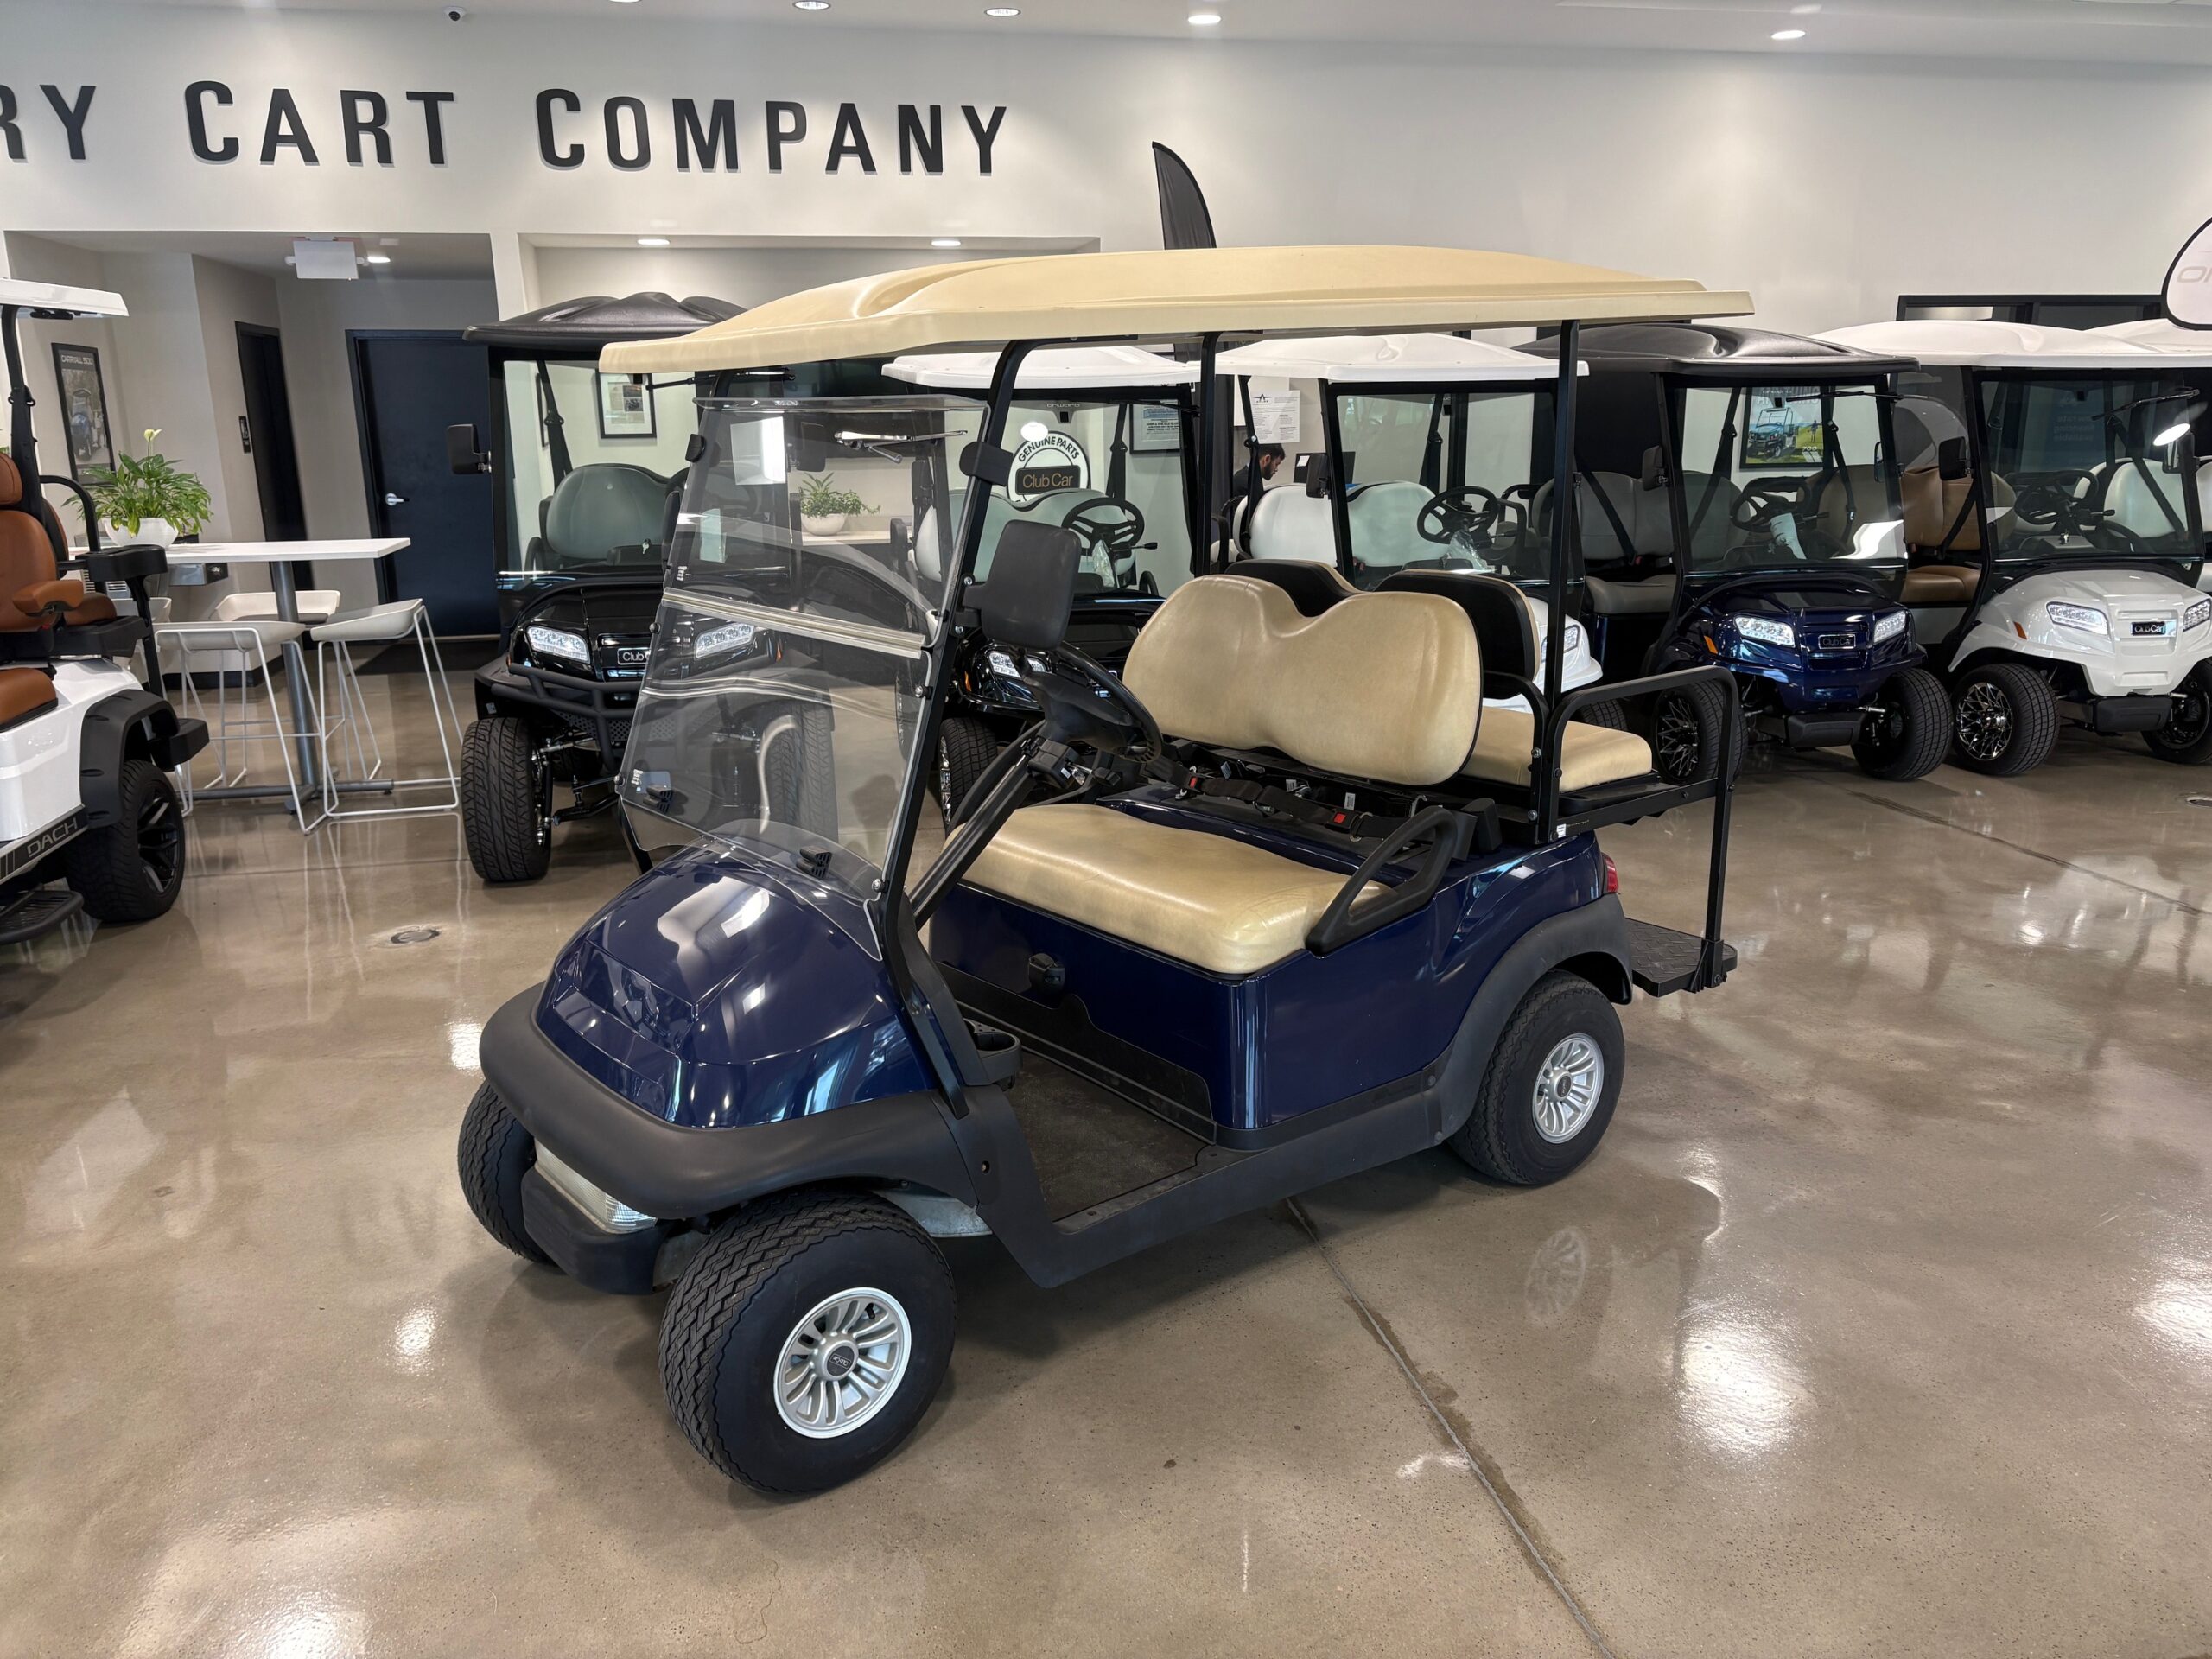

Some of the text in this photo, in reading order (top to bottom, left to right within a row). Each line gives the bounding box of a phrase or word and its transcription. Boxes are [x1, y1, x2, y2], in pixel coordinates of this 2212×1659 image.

[184, 80, 455, 165] CART
[535, 88, 1007, 175] COMPANY
[1018, 436, 1080, 462] GENUINE PARTS
[1022, 473, 1073, 488] Club Car
[2150, 624, 2163, 632] Car
[622, 651, 645, 662] Club
[27, 817, 79, 858] DACH
